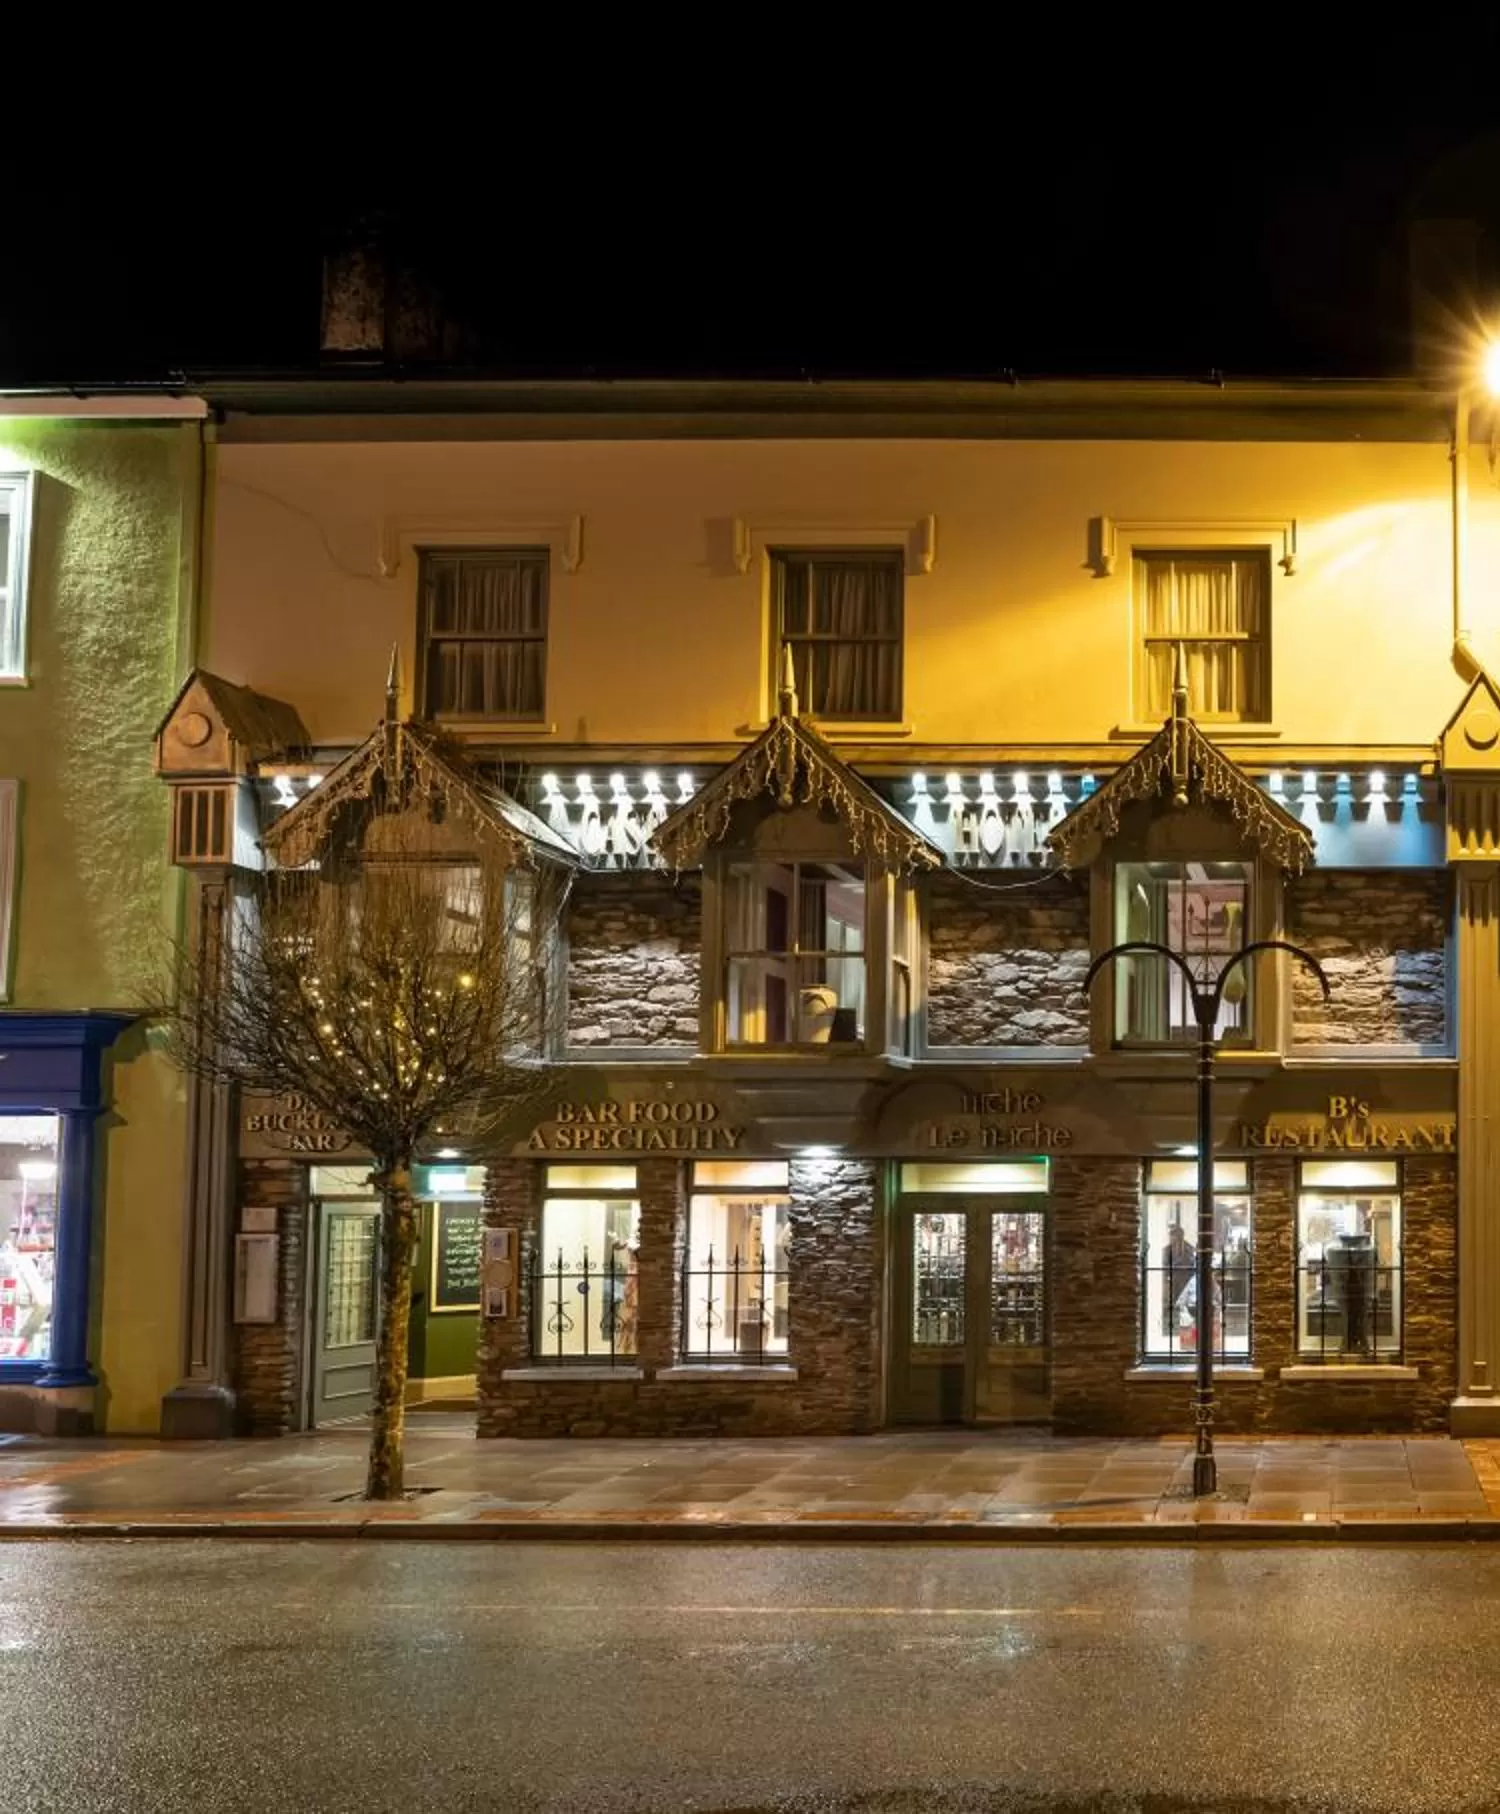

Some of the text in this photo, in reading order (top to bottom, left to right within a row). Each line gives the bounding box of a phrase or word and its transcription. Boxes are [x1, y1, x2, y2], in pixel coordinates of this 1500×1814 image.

[556, 1101, 718, 1123] BAR FOOD
[526, 1126, 746, 1150] A SPECIALITY
[1240, 1121, 1457, 1149] RESTAURANT
